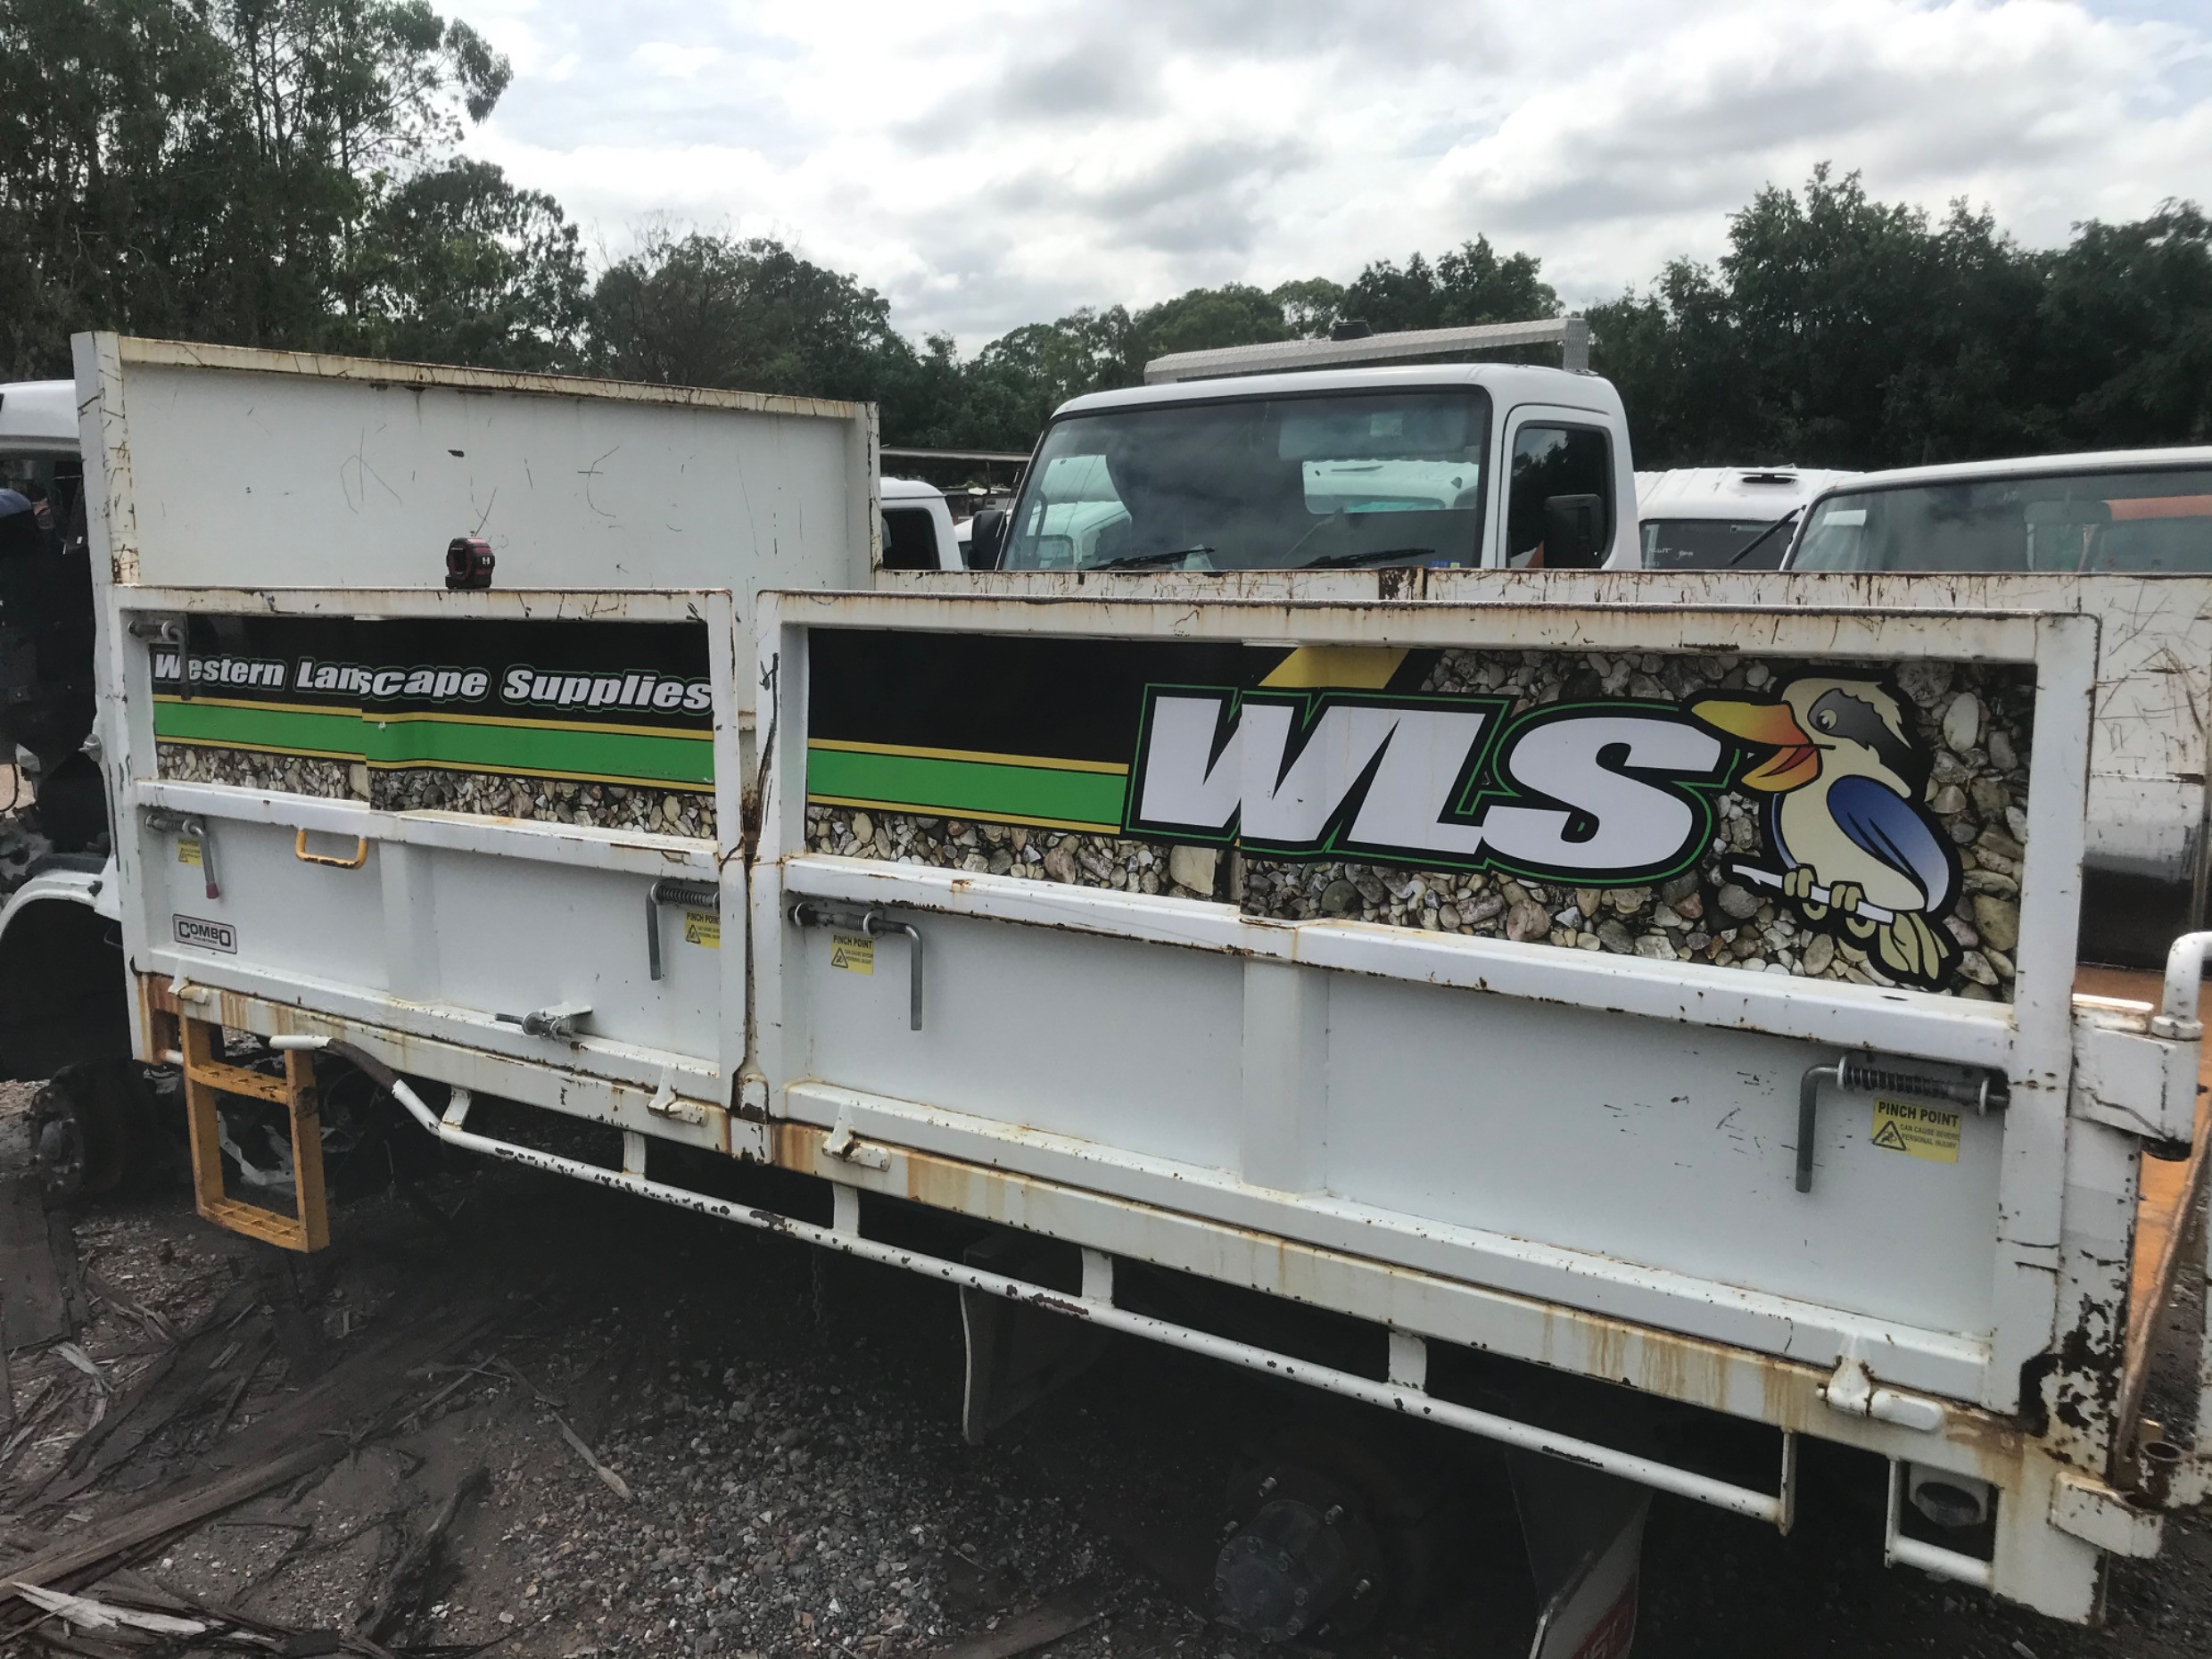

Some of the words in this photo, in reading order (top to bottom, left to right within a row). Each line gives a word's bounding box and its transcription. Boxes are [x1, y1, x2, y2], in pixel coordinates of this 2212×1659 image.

[155, 654, 285, 686] Western
[503, 670, 713, 709] Supplies
[1139, 696, 1722, 869] WLS
[178, 920, 231, 947] COMBO
[833, 934, 853, 946] PINCH
[853, 937, 873, 949] POINT
[1878, 1101, 1916, 1120] PINCH
[1919, 1109, 1960, 1127] POINT
